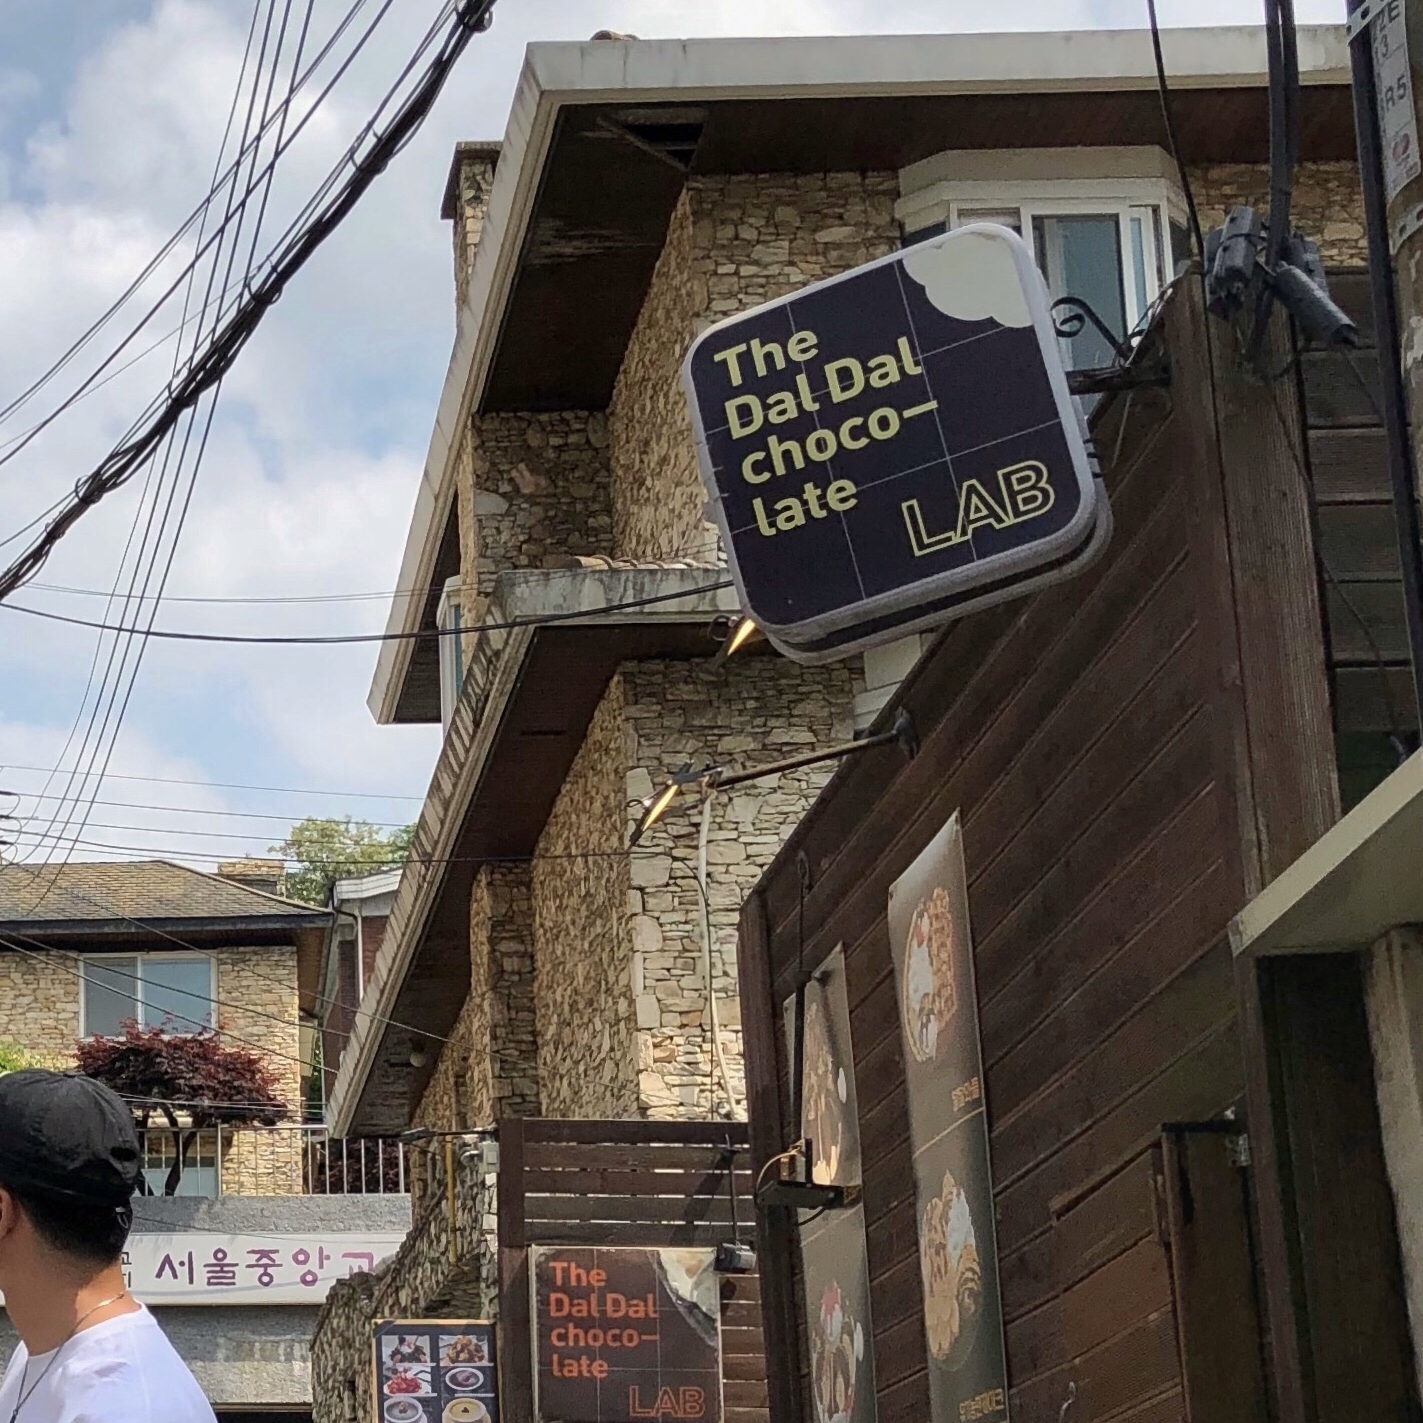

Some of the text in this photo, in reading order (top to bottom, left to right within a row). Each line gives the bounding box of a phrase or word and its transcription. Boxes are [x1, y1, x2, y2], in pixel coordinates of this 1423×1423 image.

[714, 329, 819, 387] The
[724, 336, 923, 440] Dal Dal
[741, 400, 939, 484] choco-
[752, 478, 859, 537] late
[901, 459, 1056, 557] LAB
[548, 1261, 608, 1287] The
[549, 1293, 658, 1319] Dal Dal
[550, 1323, 660, 1348] choco-
[552, 1353, 609, 1378] late
[629, 1385, 706, 1418] LAB
